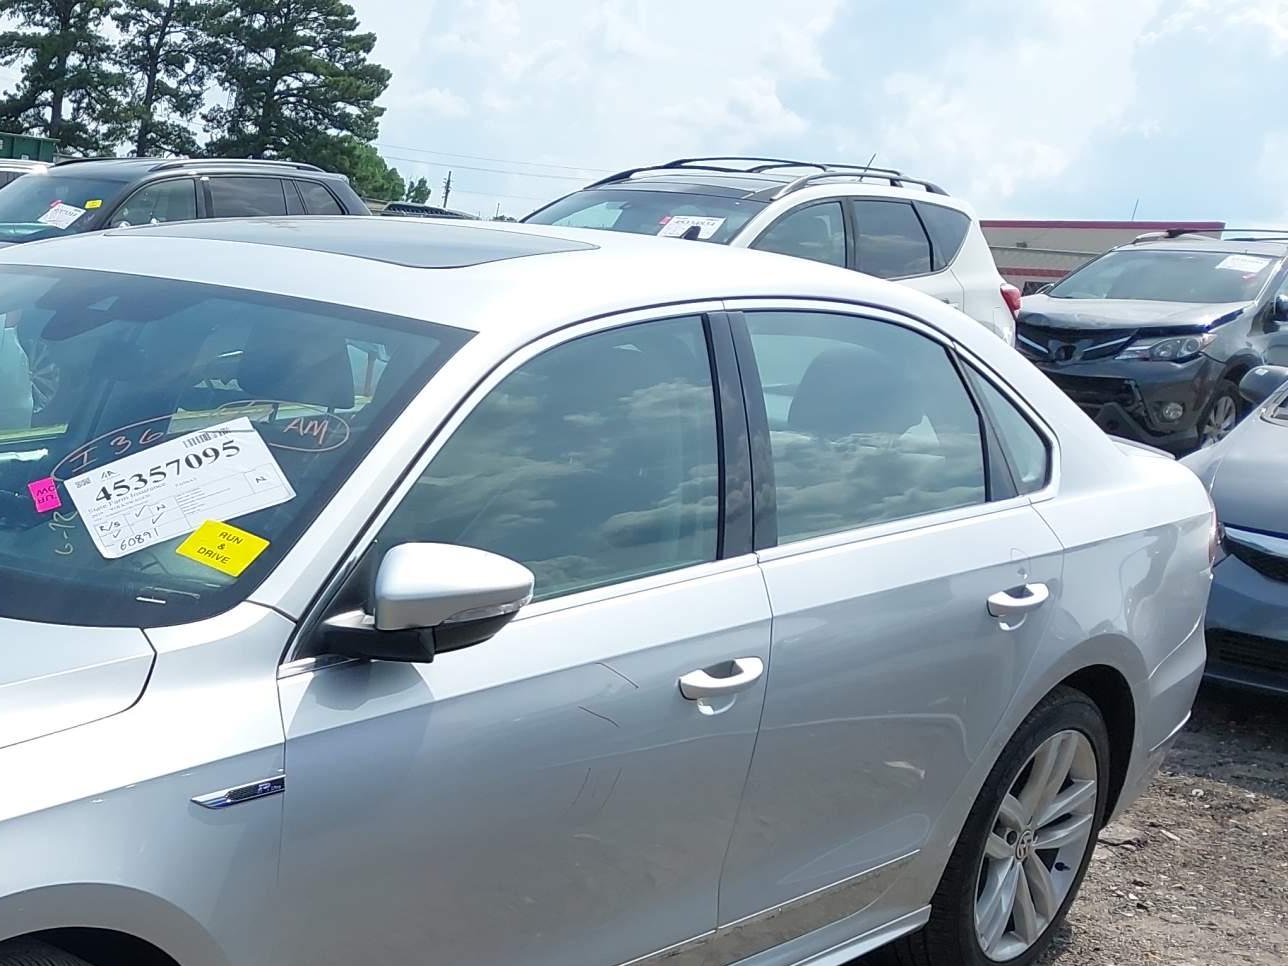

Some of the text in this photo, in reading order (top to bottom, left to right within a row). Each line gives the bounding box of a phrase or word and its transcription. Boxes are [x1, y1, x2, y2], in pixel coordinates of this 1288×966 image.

[283, 417, 329, 445] AM
[95, 439, 240, 502] 45357095
[218, 531, 244, 545] RUN
[197, 546, 232, 565] DRIVE
